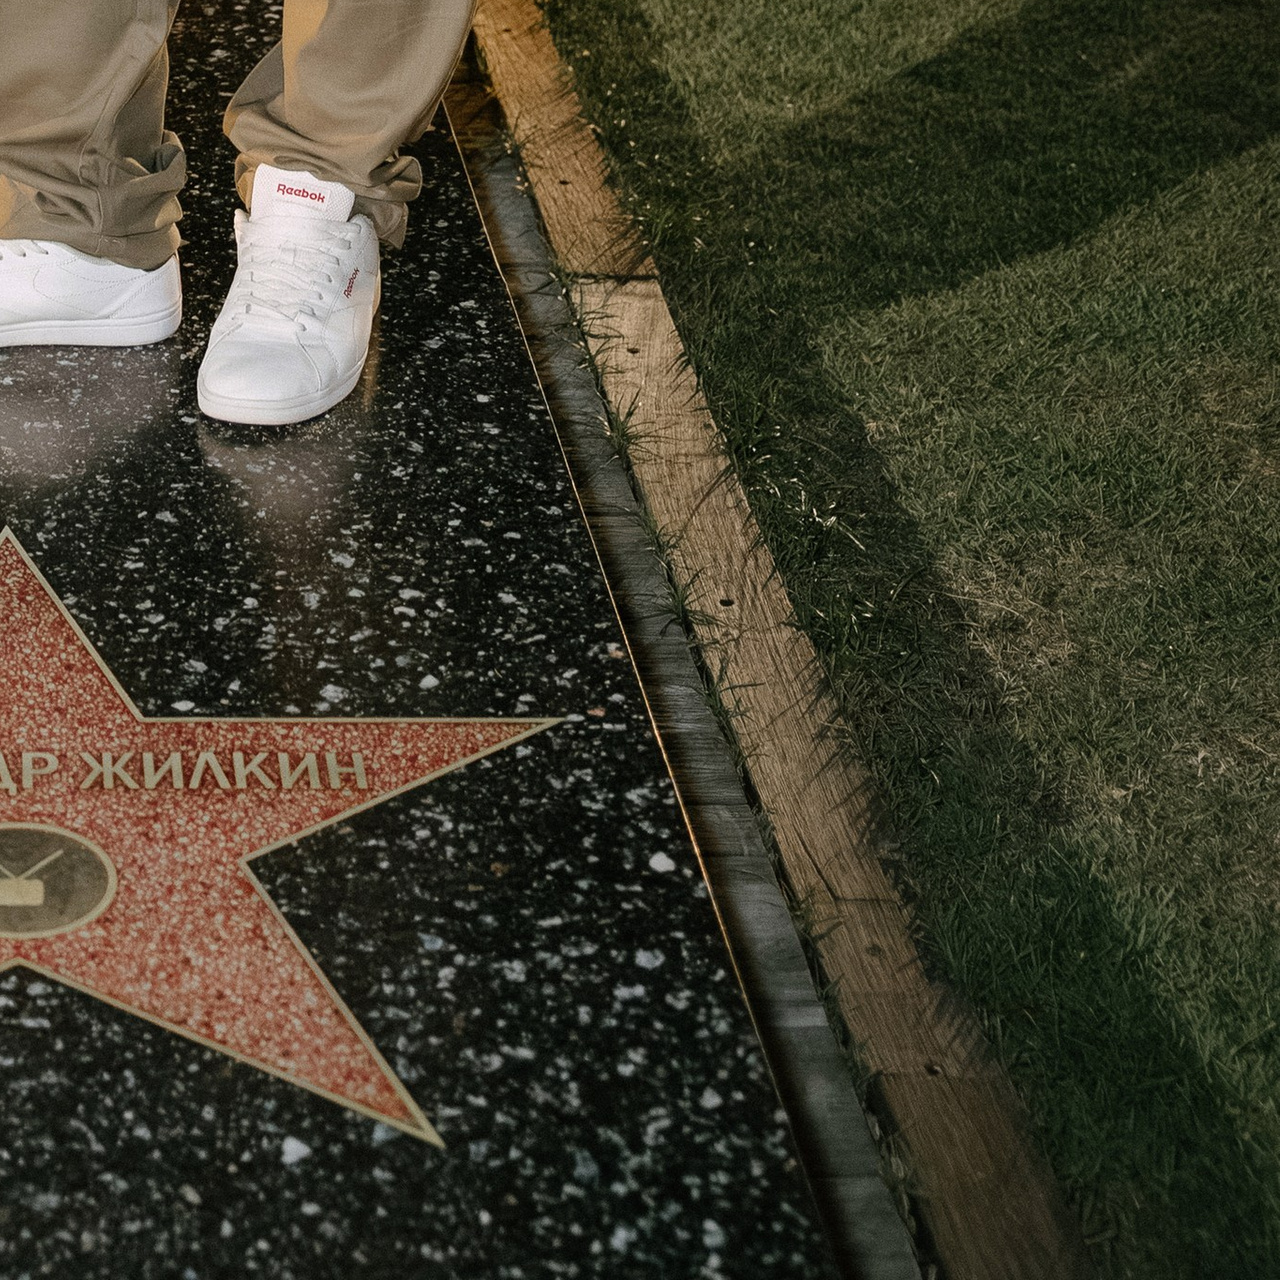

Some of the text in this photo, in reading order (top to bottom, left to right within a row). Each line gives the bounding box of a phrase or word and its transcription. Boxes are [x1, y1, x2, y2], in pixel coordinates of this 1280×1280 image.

[276, 183, 326, 203] Reebok
[343, 266, 360, 298] Reebok
[80, 748, 367, 790] ЖИЛКИН
